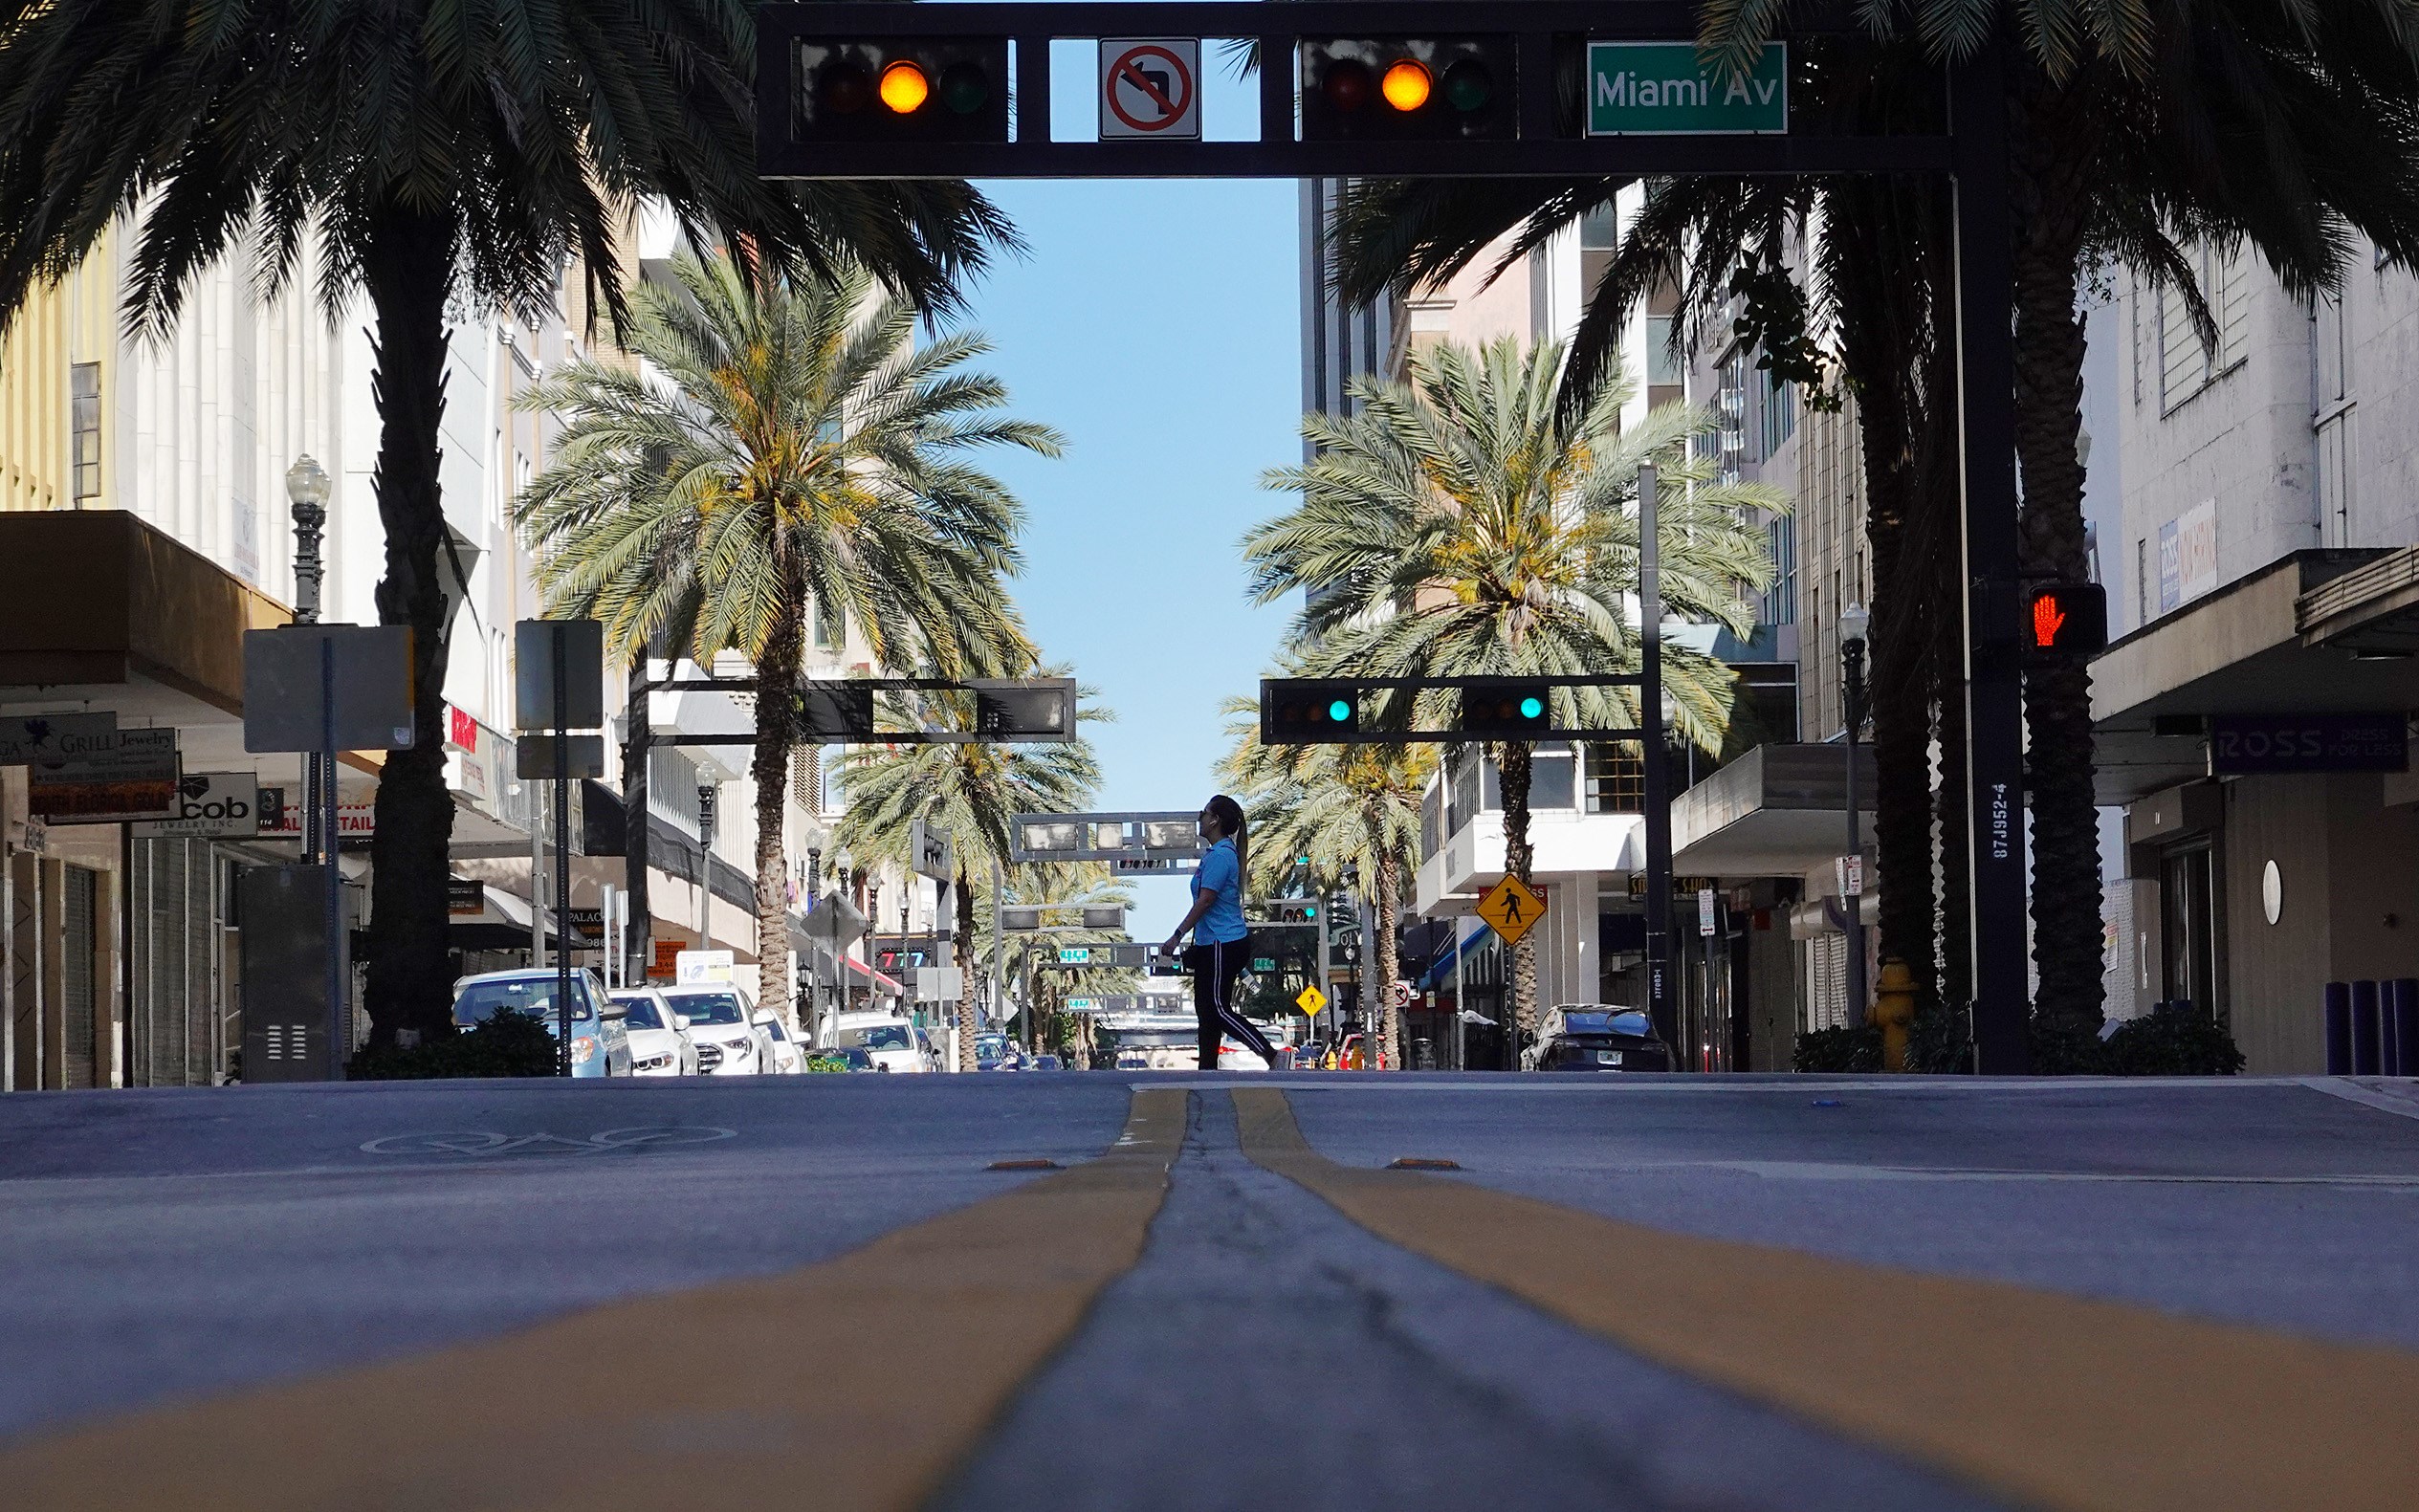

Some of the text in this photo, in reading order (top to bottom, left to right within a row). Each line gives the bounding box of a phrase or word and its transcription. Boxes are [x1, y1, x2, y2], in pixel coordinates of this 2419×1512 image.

[1597, 70, 1777, 106] Miami Av
[120, 732, 171, 749] Jewelry
[2218, 729, 2322, 757] ROSS
[2341, 728, 2389, 741] DRESS
[60, 733, 115, 754] GRILL
[2328, 743, 2403, 756] FOR LESS
[182, 797, 250, 820] cob
[153, 821, 206, 830] JEWELRY
[1991, 782, 2009, 859] 87J952-4
[568, 911, 605, 923] PALAC
[881, 952, 924, 968] 777
